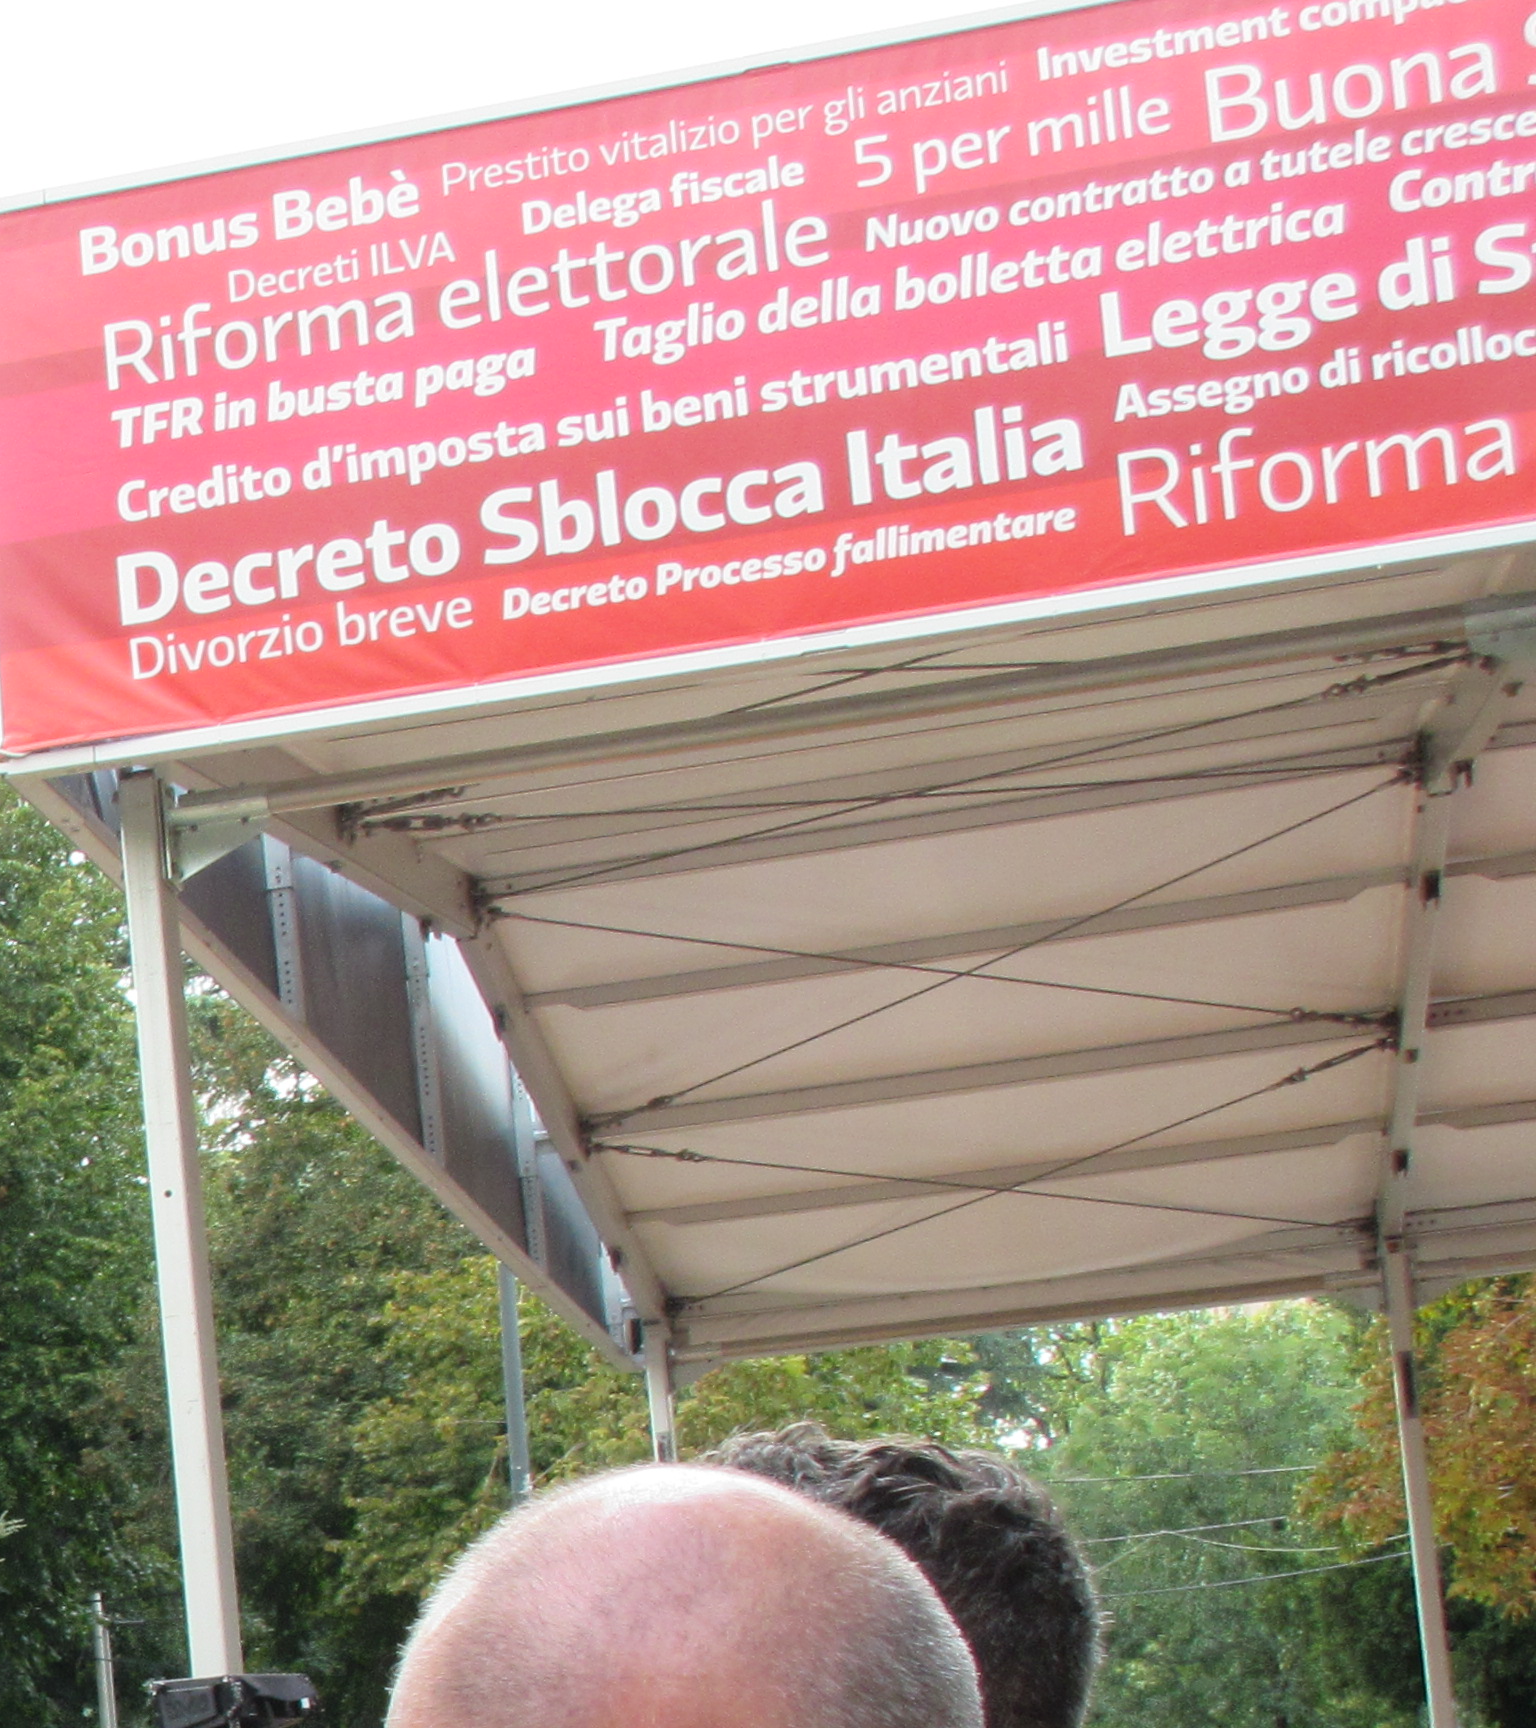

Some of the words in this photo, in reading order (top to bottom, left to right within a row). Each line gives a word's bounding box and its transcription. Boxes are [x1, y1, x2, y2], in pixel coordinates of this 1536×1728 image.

[1035, 5, 1293, 82] Investment
[1202, 40, 1499, 144] Buona
[440, 145, 592, 197] Prestito
[597, 114, 743, 167] vitalizio
[749, 103, 815, 151] per
[822, 84, 867, 138] gli
[875, 59, 1010, 117] anziani
[852, 132, 895, 189] 5
[911, 124, 1013, 195] per
[1026, 83, 1173, 158] mille
[77, 210, 261, 278] Bonus
[271, 167, 422, 242] Bebè
[519, 186, 664, 237] Delega
[667, 153, 807, 209] fiscale
[864, 204, 1001, 253] Nuovo
[1007, 164, 1217, 228] contratto
[1223, 158, 1252, 189] a
[1258, 126, 1393, 183] tutele
[102, 289, 416, 392] Riforma
[437, 196, 831, 331] elettorale
[226, 253, 361, 304] Decreti
[369, 230, 458, 278] ILVA
[592, 300, 748, 367] Taglio
[756, 274, 883, 336] della
[893, 244, 1104, 312] bolletta
[1114, 200, 1347, 273] elettrica
[1098, 271, 1360, 361] Legge
[1377, 235, 1456, 312] di
[1473, 221, 1536, 295] S
[109, 395, 205, 450] TFR
[212, 390, 258, 433] in
[266, 369, 406, 424] busta
[413, 346, 537, 410] paga
[116, 463, 293, 523] Credito
[555, 394, 631, 448] sui
[639, 374, 750, 434] beni
[759, 319, 1070, 413] strumentali
[1113, 365, 1311, 424] Assegno
[1318, 346, 1363, 390] di
[115, 518, 462, 627] Decreto
[478, 460, 825, 566] Sblocca
[845, 404, 1085, 507] Italia
[1116, 417, 1517, 537] Riforma
[502, 574, 649, 621] Decreto
[655, 546, 828, 597] Processo
[829, 506, 1077, 579] fallimentare
[128, 612, 325, 682] Divorzio
[335, 596, 475, 647] breve
